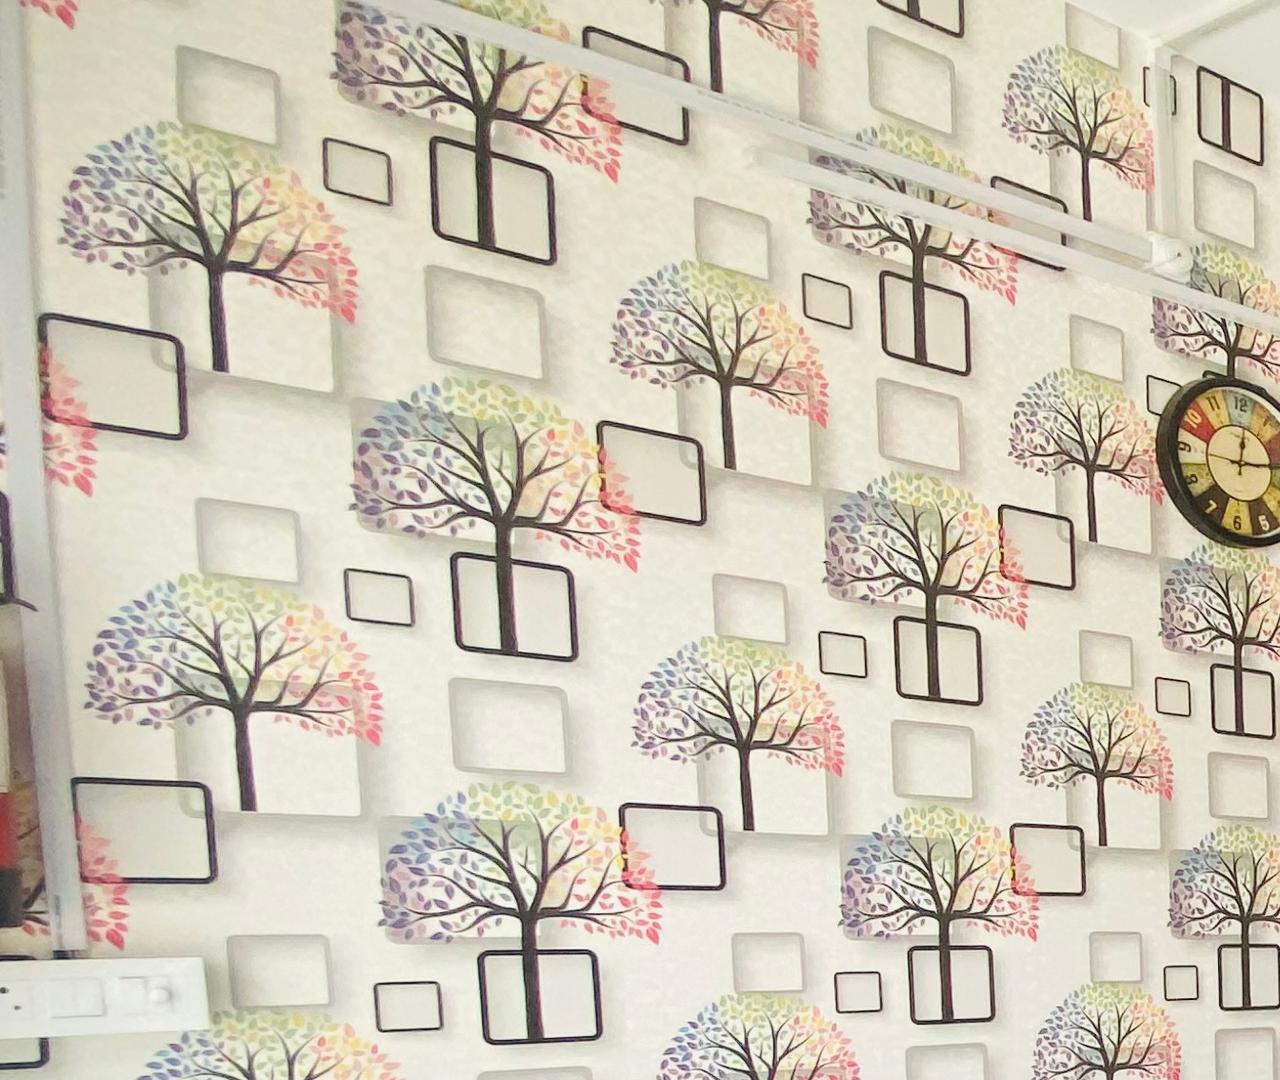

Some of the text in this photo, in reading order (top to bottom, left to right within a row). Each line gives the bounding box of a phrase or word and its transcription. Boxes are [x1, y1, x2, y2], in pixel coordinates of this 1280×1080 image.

[1206, 395, 1221, 411] 11
[1234, 397, 1249, 413] 12
[1184, 412, 1203, 428] 10
[1179, 441, 1192, 453] 9
[1186, 474, 1198, 485] 8
[1204, 499, 1218, 514] 7
[1232, 515, 1242, 531] 6
[1258, 514, 1270, 531] 5
